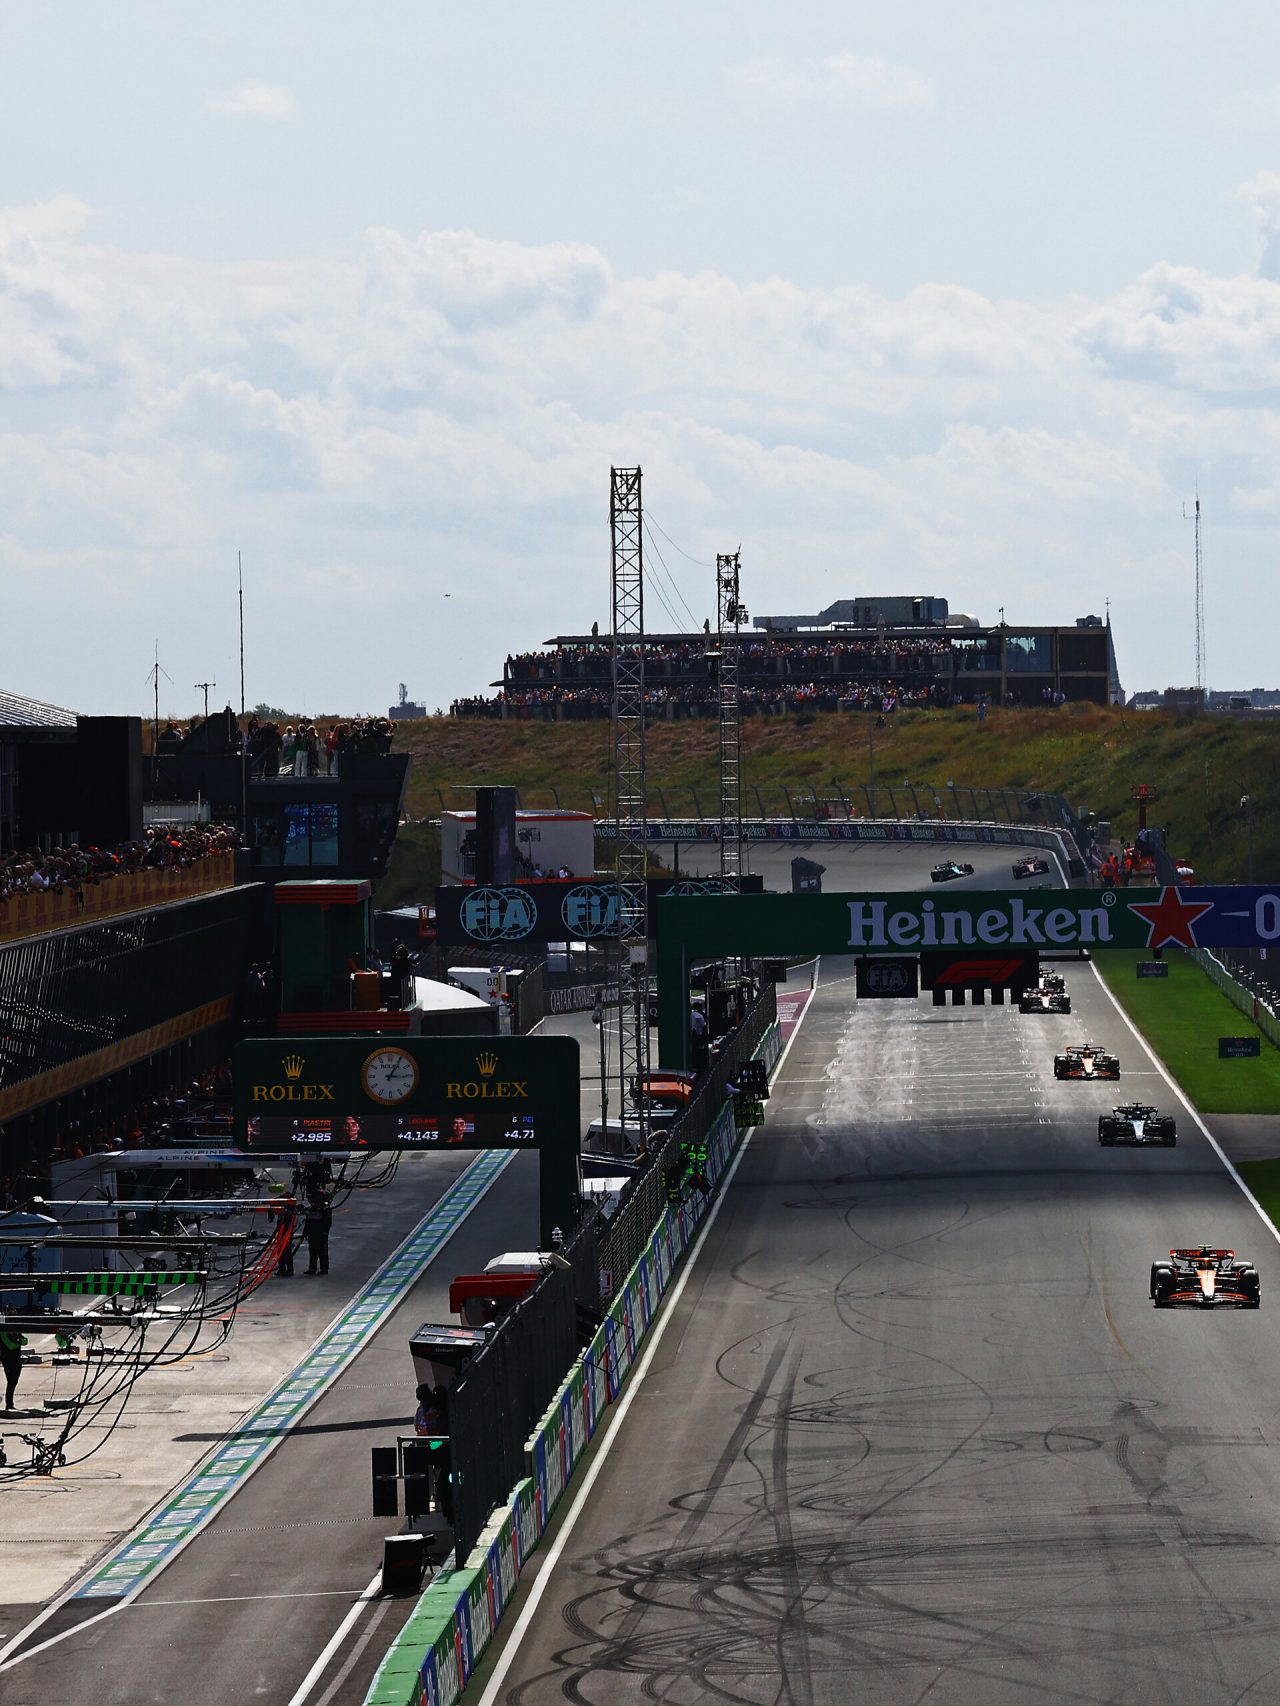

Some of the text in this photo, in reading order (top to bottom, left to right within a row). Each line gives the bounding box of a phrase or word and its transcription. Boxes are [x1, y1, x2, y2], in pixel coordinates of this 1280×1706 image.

[847, 898, 1114, 946] Heineken
[935, 959, 1026, 985] F1
[251, 1084, 336, 1101] ROLEX
[446, 1081, 530, 1098] ROLEX
[292, 1119, 299, 1127] 4
[291, 1132, 333, 1142] +2.985
[397, 1131, 440, 1141] +4.143
